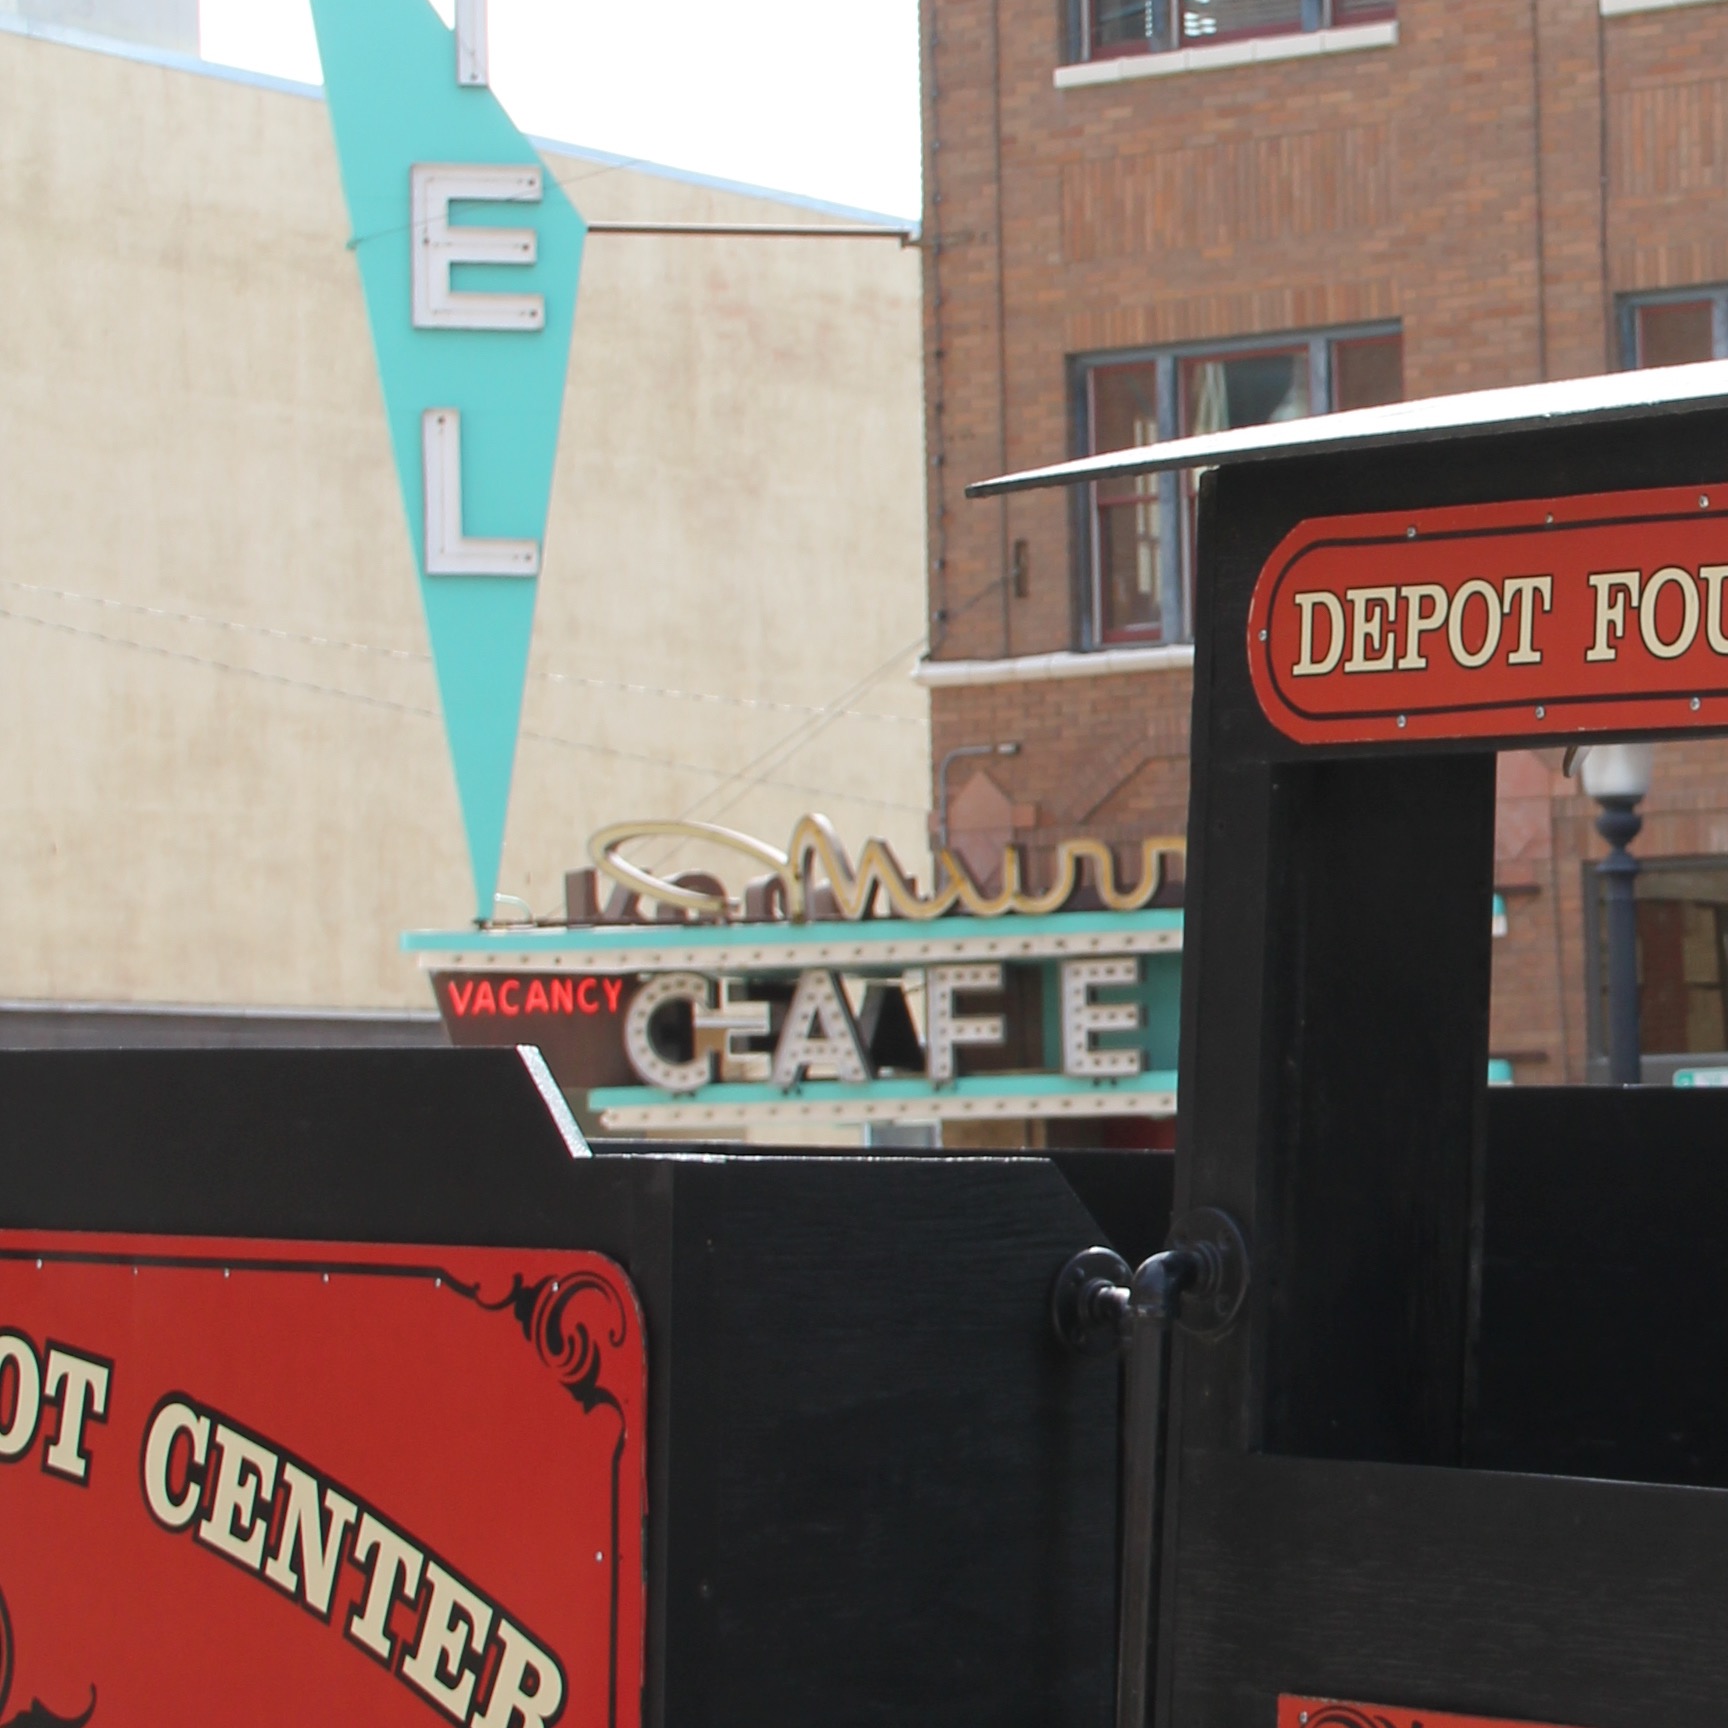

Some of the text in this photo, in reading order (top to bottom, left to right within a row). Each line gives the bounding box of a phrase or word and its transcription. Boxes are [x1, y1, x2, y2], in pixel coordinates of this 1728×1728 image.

[1291, 574, 1553, 676] DEPOT
[448, 977, 623, 1017] VACANCY
[624, 958, 1143, 1091] CAFE
